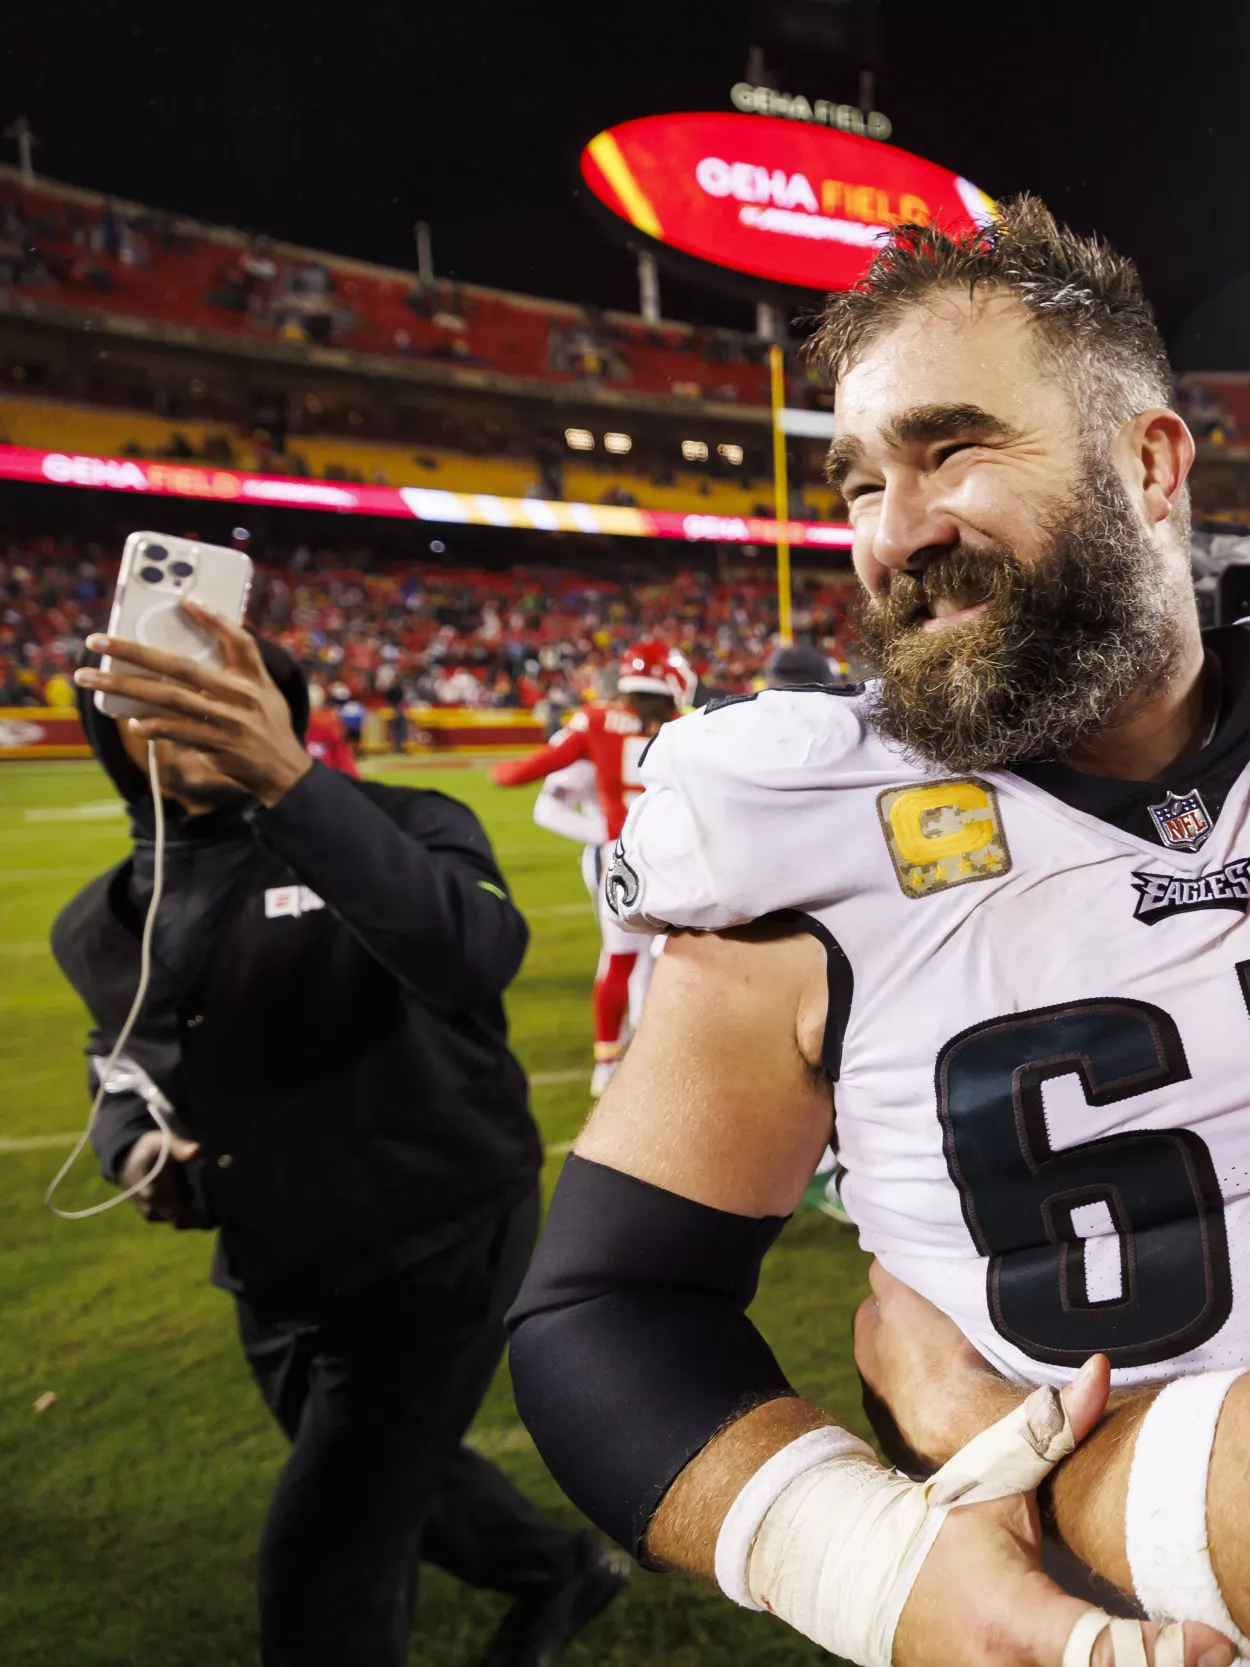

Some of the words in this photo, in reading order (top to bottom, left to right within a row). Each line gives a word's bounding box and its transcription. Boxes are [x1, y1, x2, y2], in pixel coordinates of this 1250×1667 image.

[696, 157, 819, 213] GEHA
[821, 179, 930, 228] FIELD
[42, 453, 148, 491] GEHA
[890, 783, 994, 865] C
[1164, 811, 1208, 841] NFL
